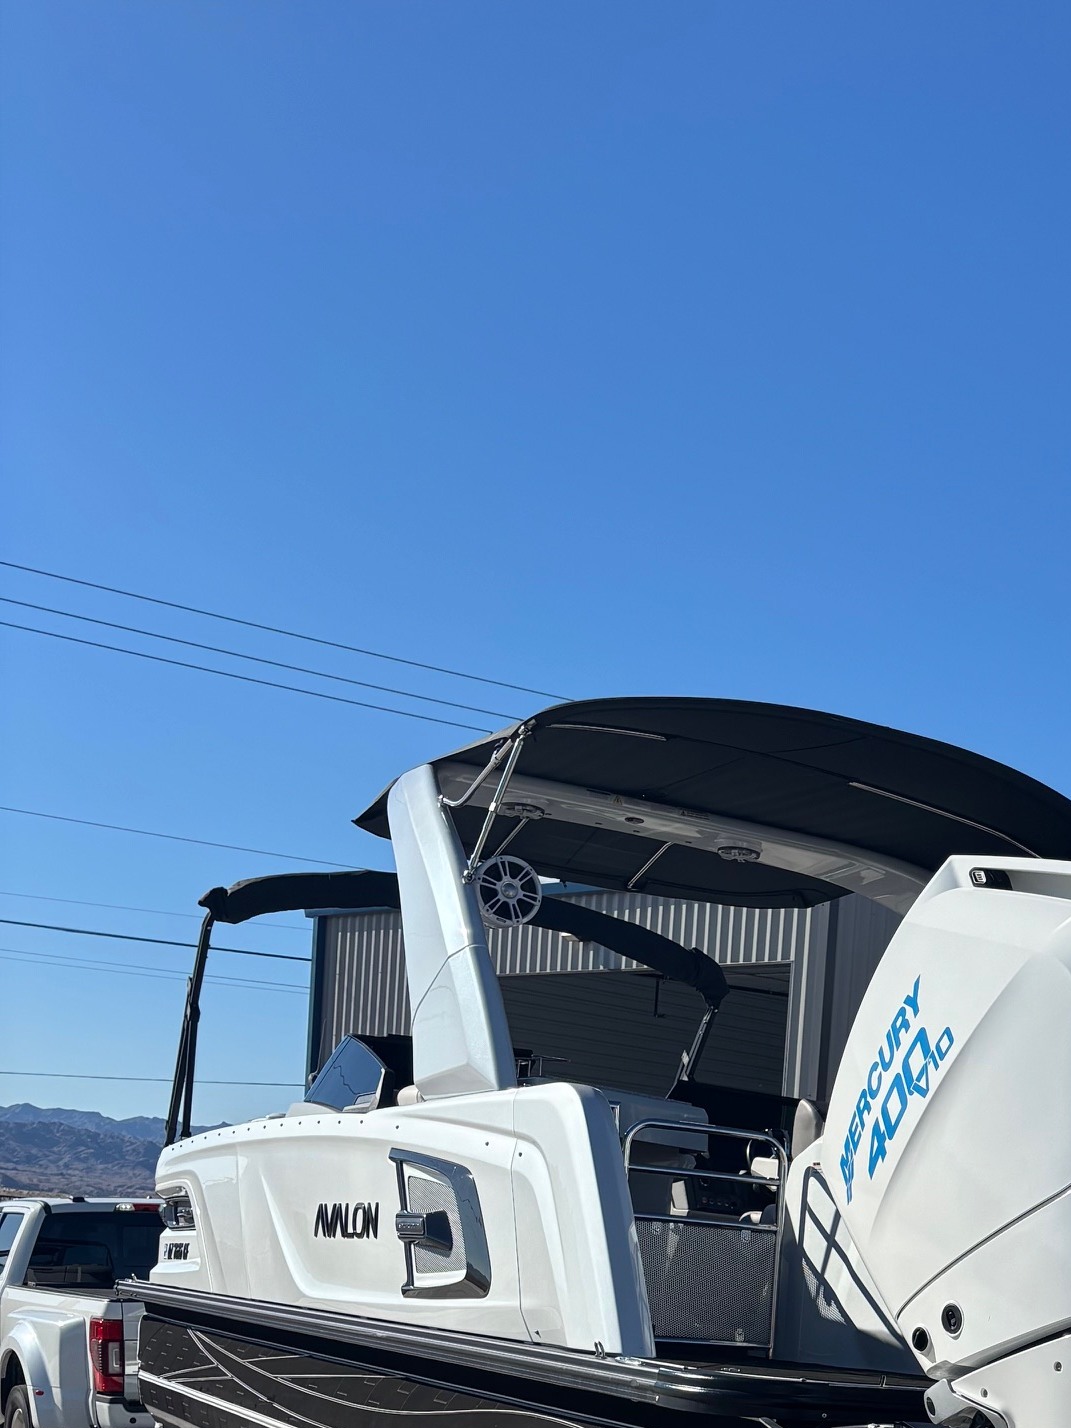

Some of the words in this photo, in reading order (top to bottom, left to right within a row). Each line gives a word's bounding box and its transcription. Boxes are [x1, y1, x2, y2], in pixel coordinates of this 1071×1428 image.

[839, 974, 921, 1206] MERCURY
[868, 1026, 931, 1181] 400
[912, 1026, 955, 1099] V10
[313, 1202, 380, 1239] AVALON
